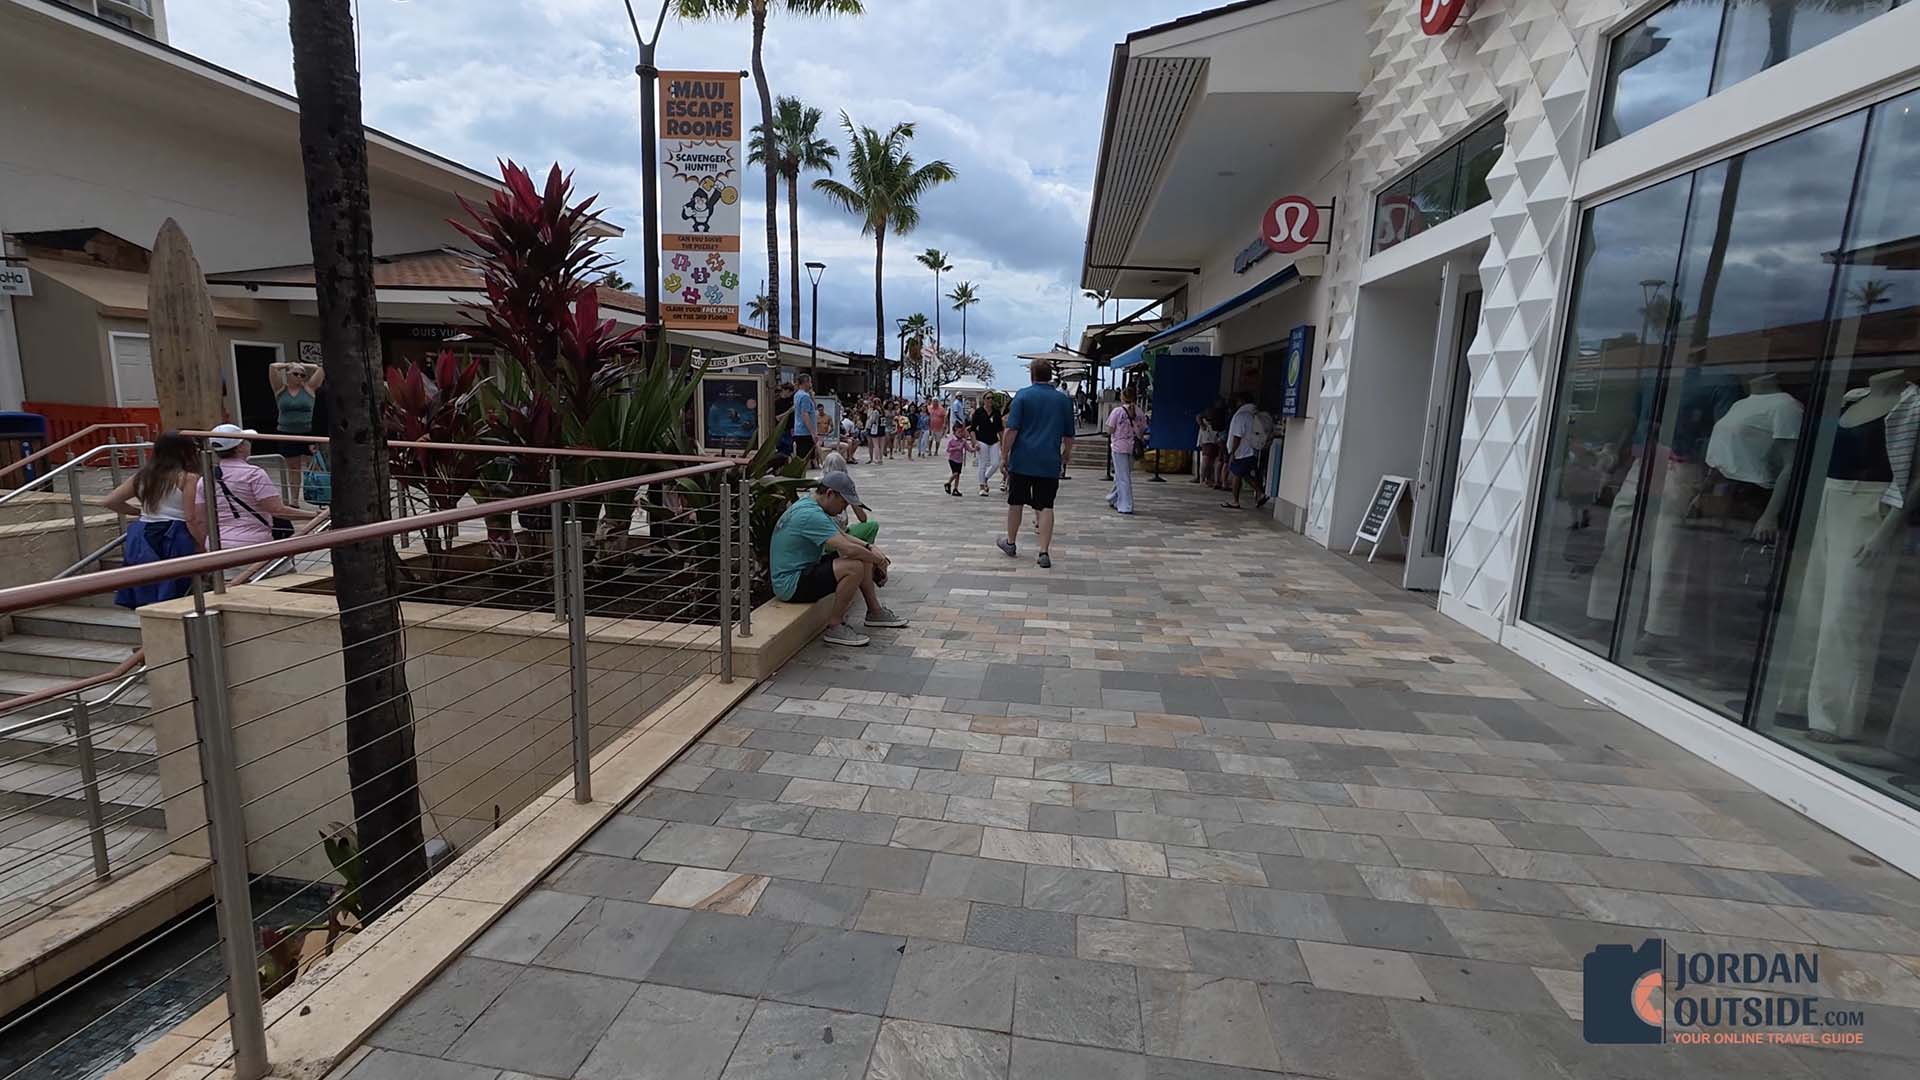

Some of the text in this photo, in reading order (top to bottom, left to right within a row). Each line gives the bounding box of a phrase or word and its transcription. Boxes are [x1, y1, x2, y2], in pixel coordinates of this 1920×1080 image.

[674, 81, 725, 99] MAUI
[666, 100, 734, 119] ESCAPE
[666, 119, 733, 137] ROOMS
[676, 153, 726, 163] SCAVENGER
[685, 163, 718, 172] HUNT!!!
[698, 272, 704, 282] 3
[725, 278, 732, 287] 6
